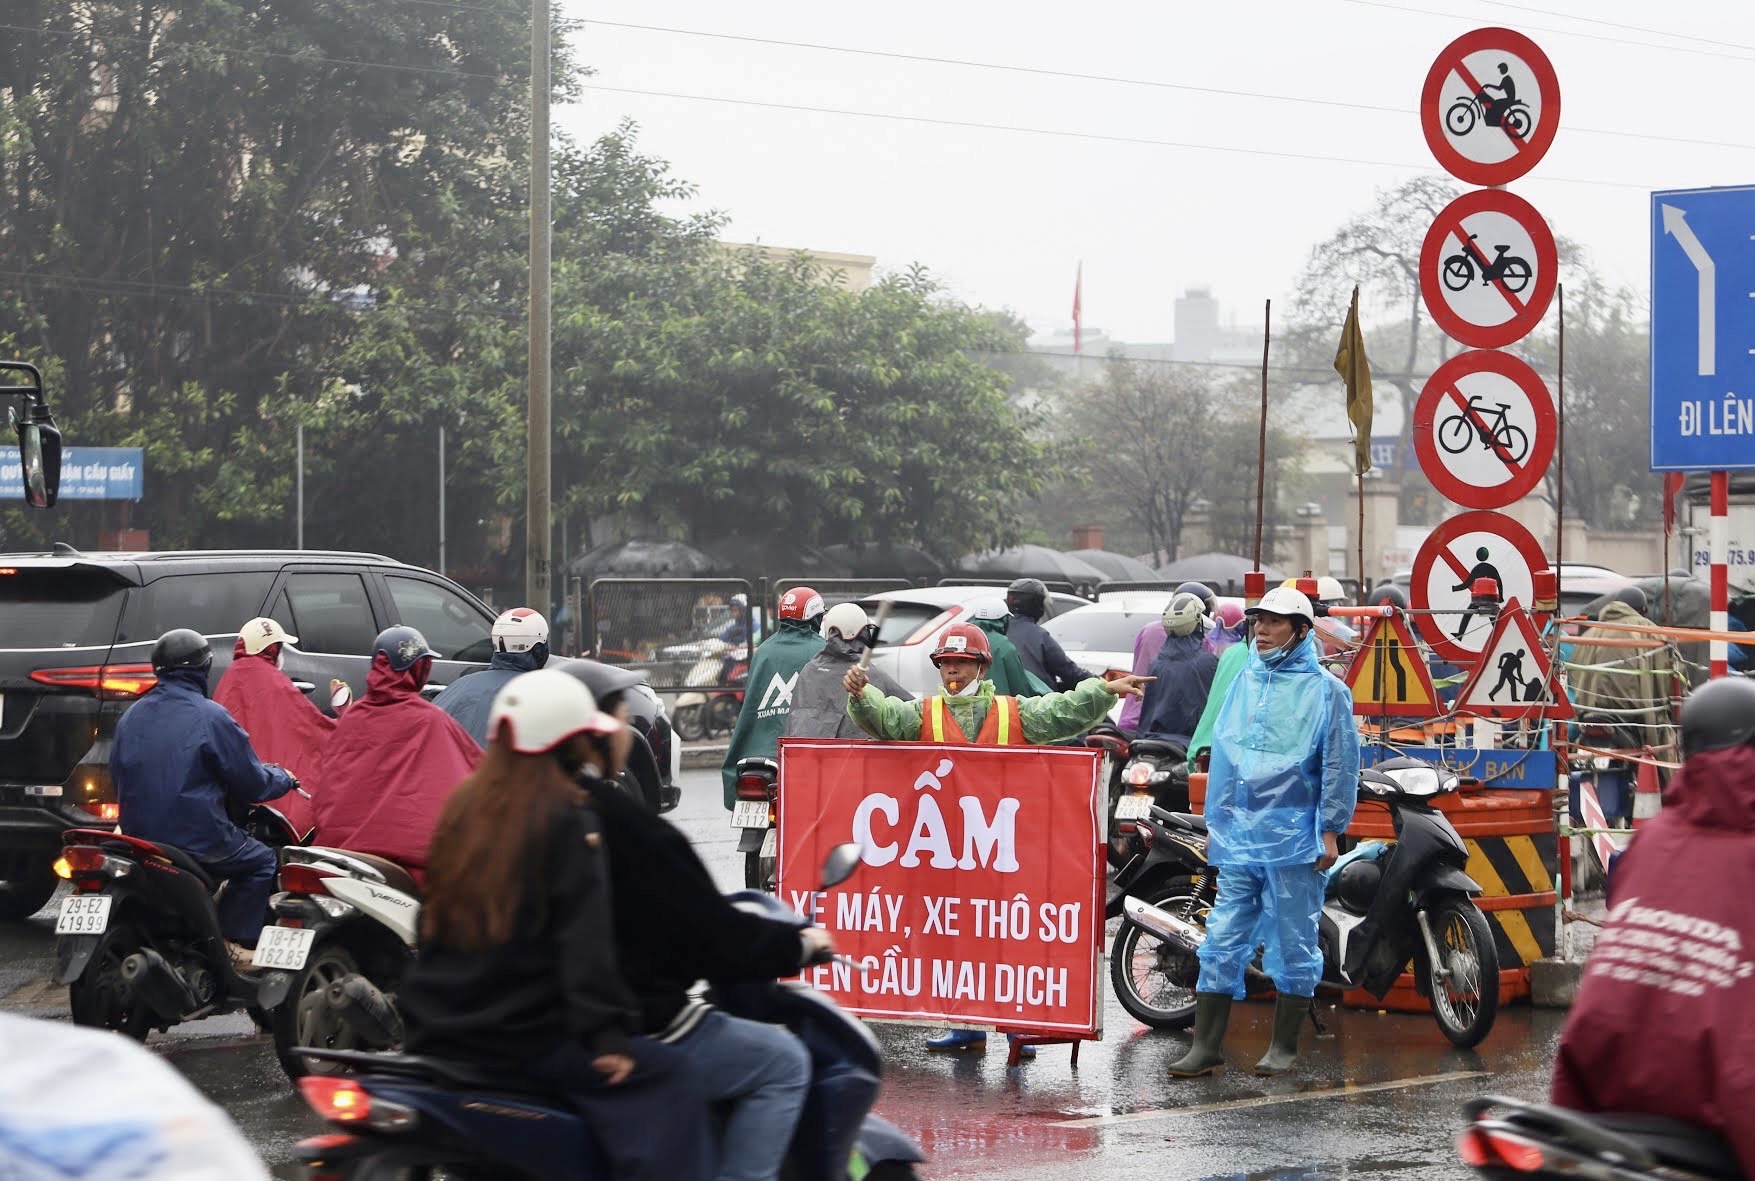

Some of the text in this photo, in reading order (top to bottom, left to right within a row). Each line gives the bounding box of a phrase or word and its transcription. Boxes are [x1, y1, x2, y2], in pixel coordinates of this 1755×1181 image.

[1679, 391, 1753, 436] ĐI LÊN
[736, 815, 766, 827] 6112
[852, 759, 1020, 872] CẤM
[67, 899, 103, 914] 29-E2
[791, 885, 1081, 944] XE MÁY, XE THÔ SƠ
[59, 916, 103, 932] 419.99
[269, 930, 305, 949] 18-F1
[259, 947, 305, 967] 162.85
[861, 944, 922, 997] CẦU
[931, 959, 986, 1001] MAI
[994, 963, 1067, 1013] DỊCH
